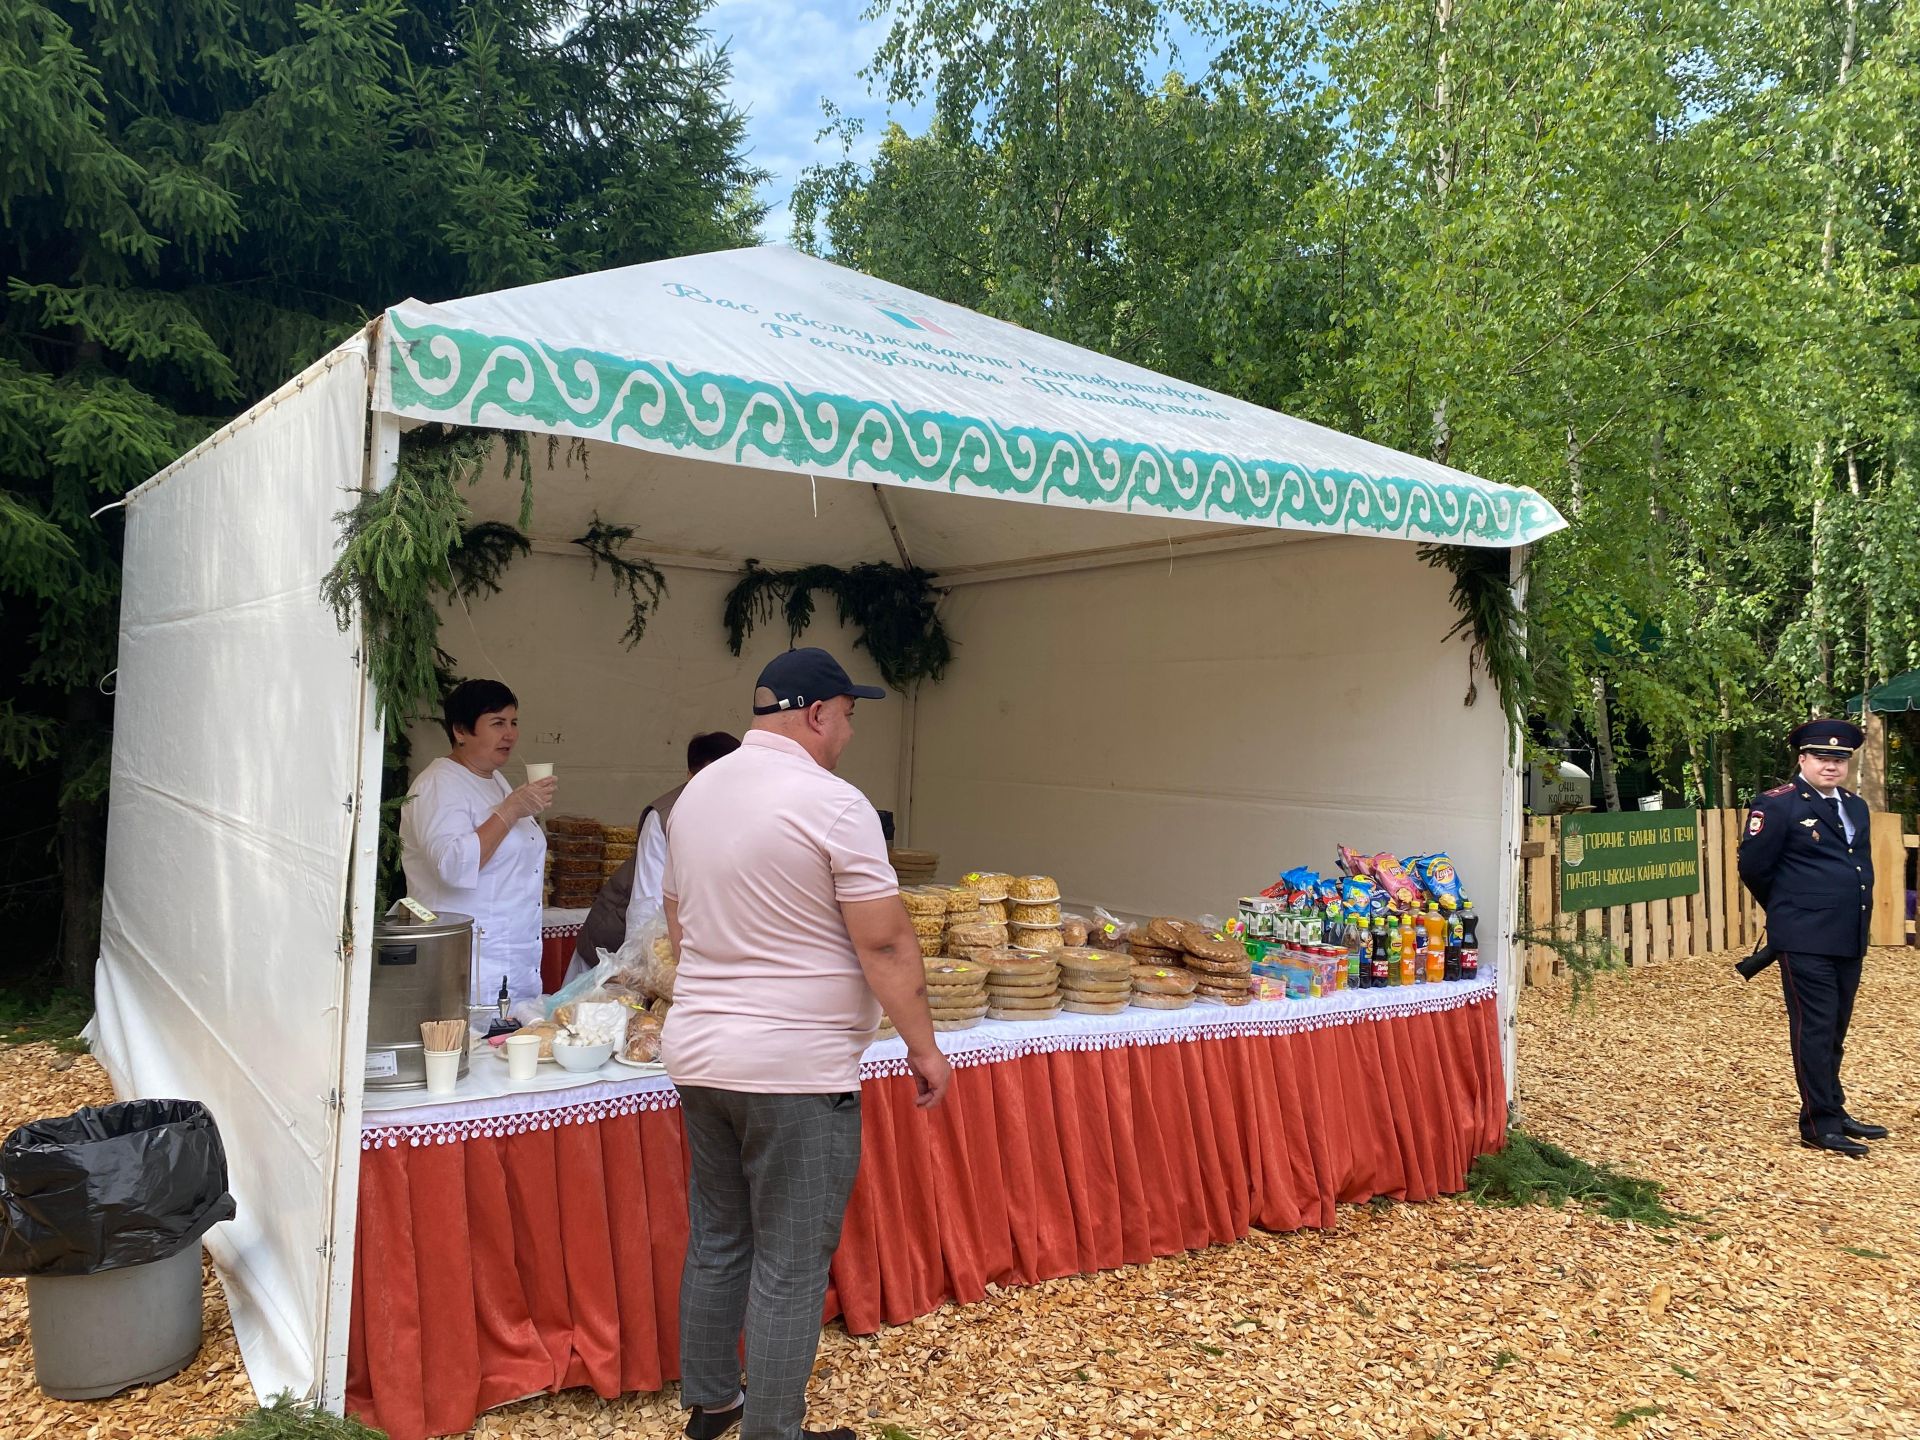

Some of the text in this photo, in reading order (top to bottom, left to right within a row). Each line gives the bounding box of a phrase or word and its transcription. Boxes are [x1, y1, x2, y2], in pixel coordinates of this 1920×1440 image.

[662, 282, 1212, 402] Вас обслуживают кооператоры
[761, 322, 1232, 421] Республики Татарстан
[1585, 826, 1694, 850] ГОРЯЧИЕ БЛИНЫ ИЗ ПЕЧИ
[1603, 866, 1636, 885] ЧЫККАН
[1638, 861, 1667, 881] КАЙНАР
[1669, 859, 1696, 878] КОЙМАК
